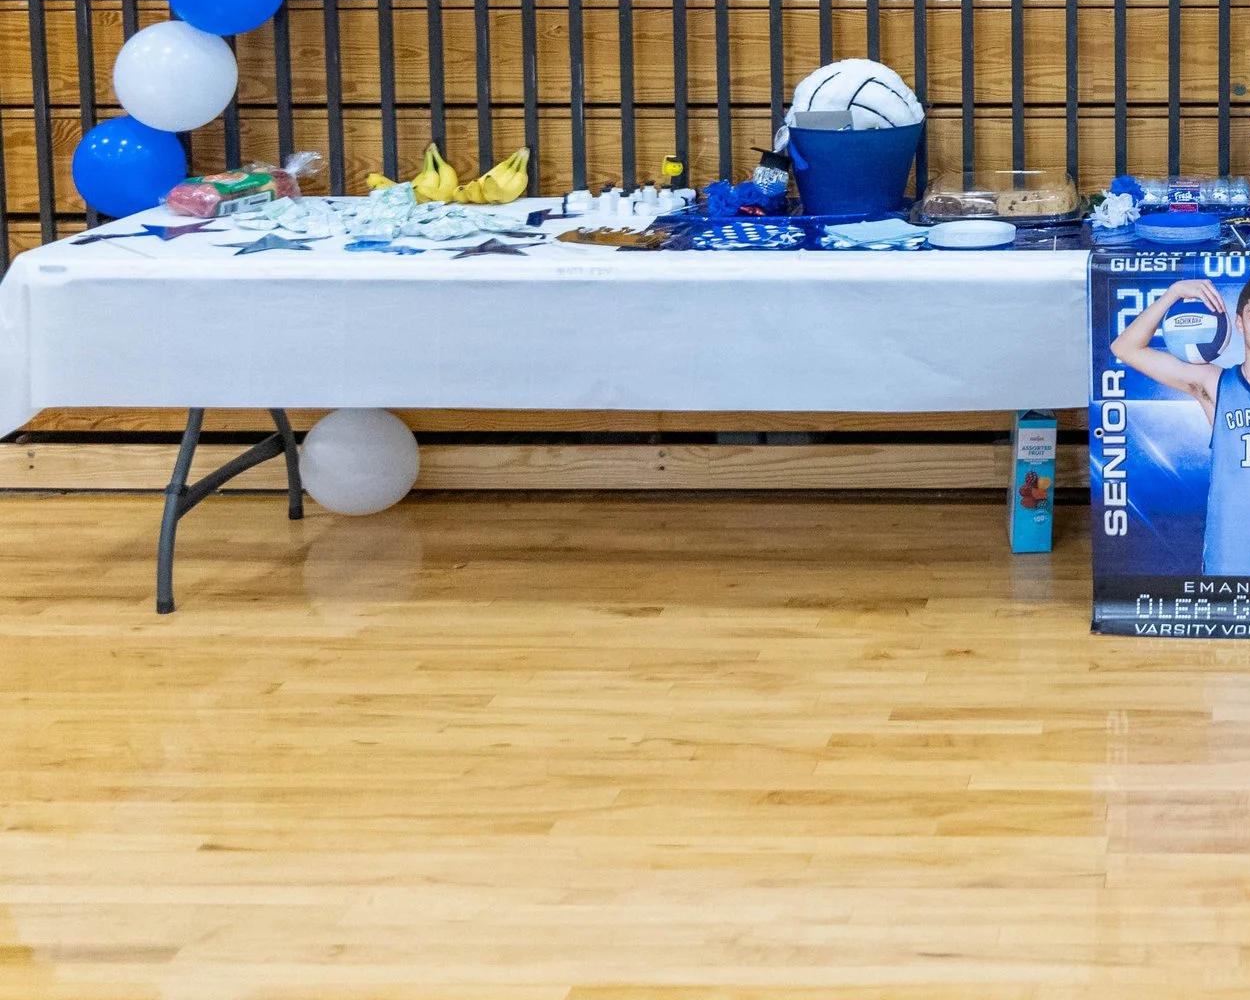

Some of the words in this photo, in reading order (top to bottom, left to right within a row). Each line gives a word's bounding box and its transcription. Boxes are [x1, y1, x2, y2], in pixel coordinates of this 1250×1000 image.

[1110, 257, 1181, 272] GUEST
[1102, 369, 1128, 536] SENIOR
[1134, 623, 1217, 636] VARSITY
